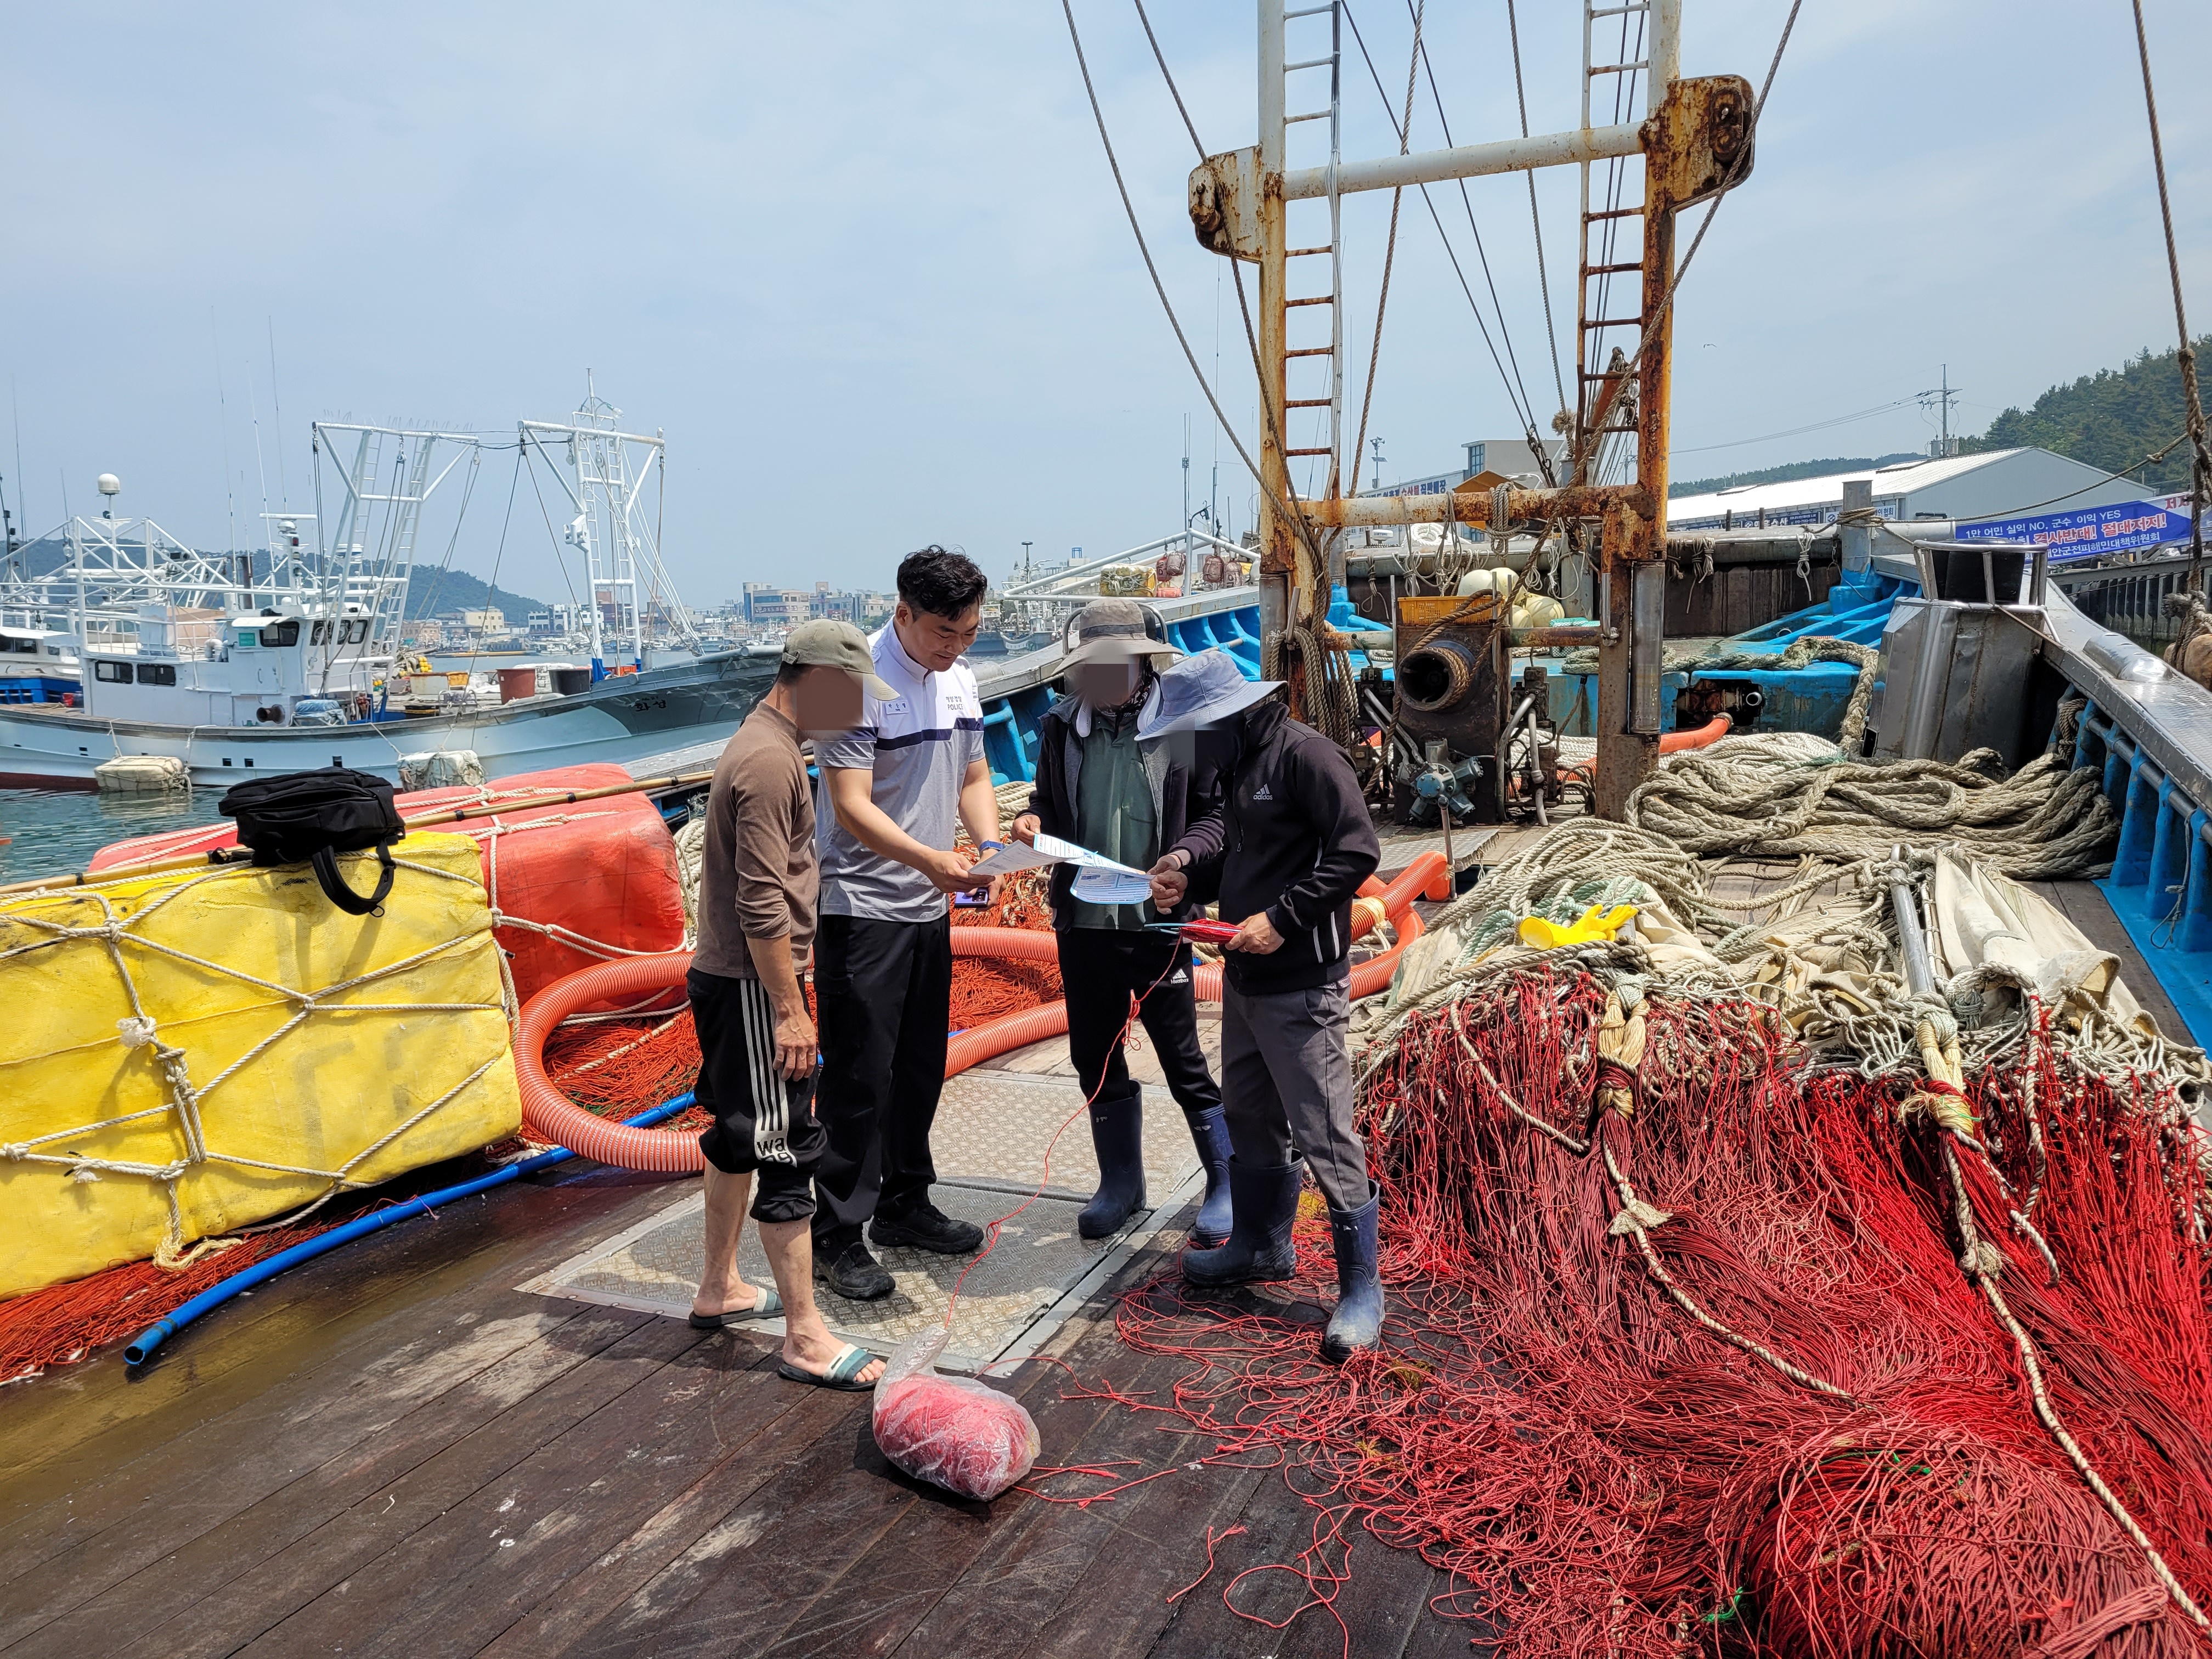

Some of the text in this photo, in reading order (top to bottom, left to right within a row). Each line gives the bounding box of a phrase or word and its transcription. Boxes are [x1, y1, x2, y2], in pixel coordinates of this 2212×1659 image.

[1966, 529, 1981, 539] 1만
[1984, 526, 2003, 536] 어민
[2006, 523, 2026, 534] 실익
[2051, 517, 2072, 528] 군수
[2076, 513, 2096, 524] 이익
[2099, 510, 2121, 521] YES
[2033, 524, 2097, 545] 결사반대!
[2101, 513, 2166, 537] 절대저지!
[2047, 532, 2160, 558] 안군전피해민대책위원회
